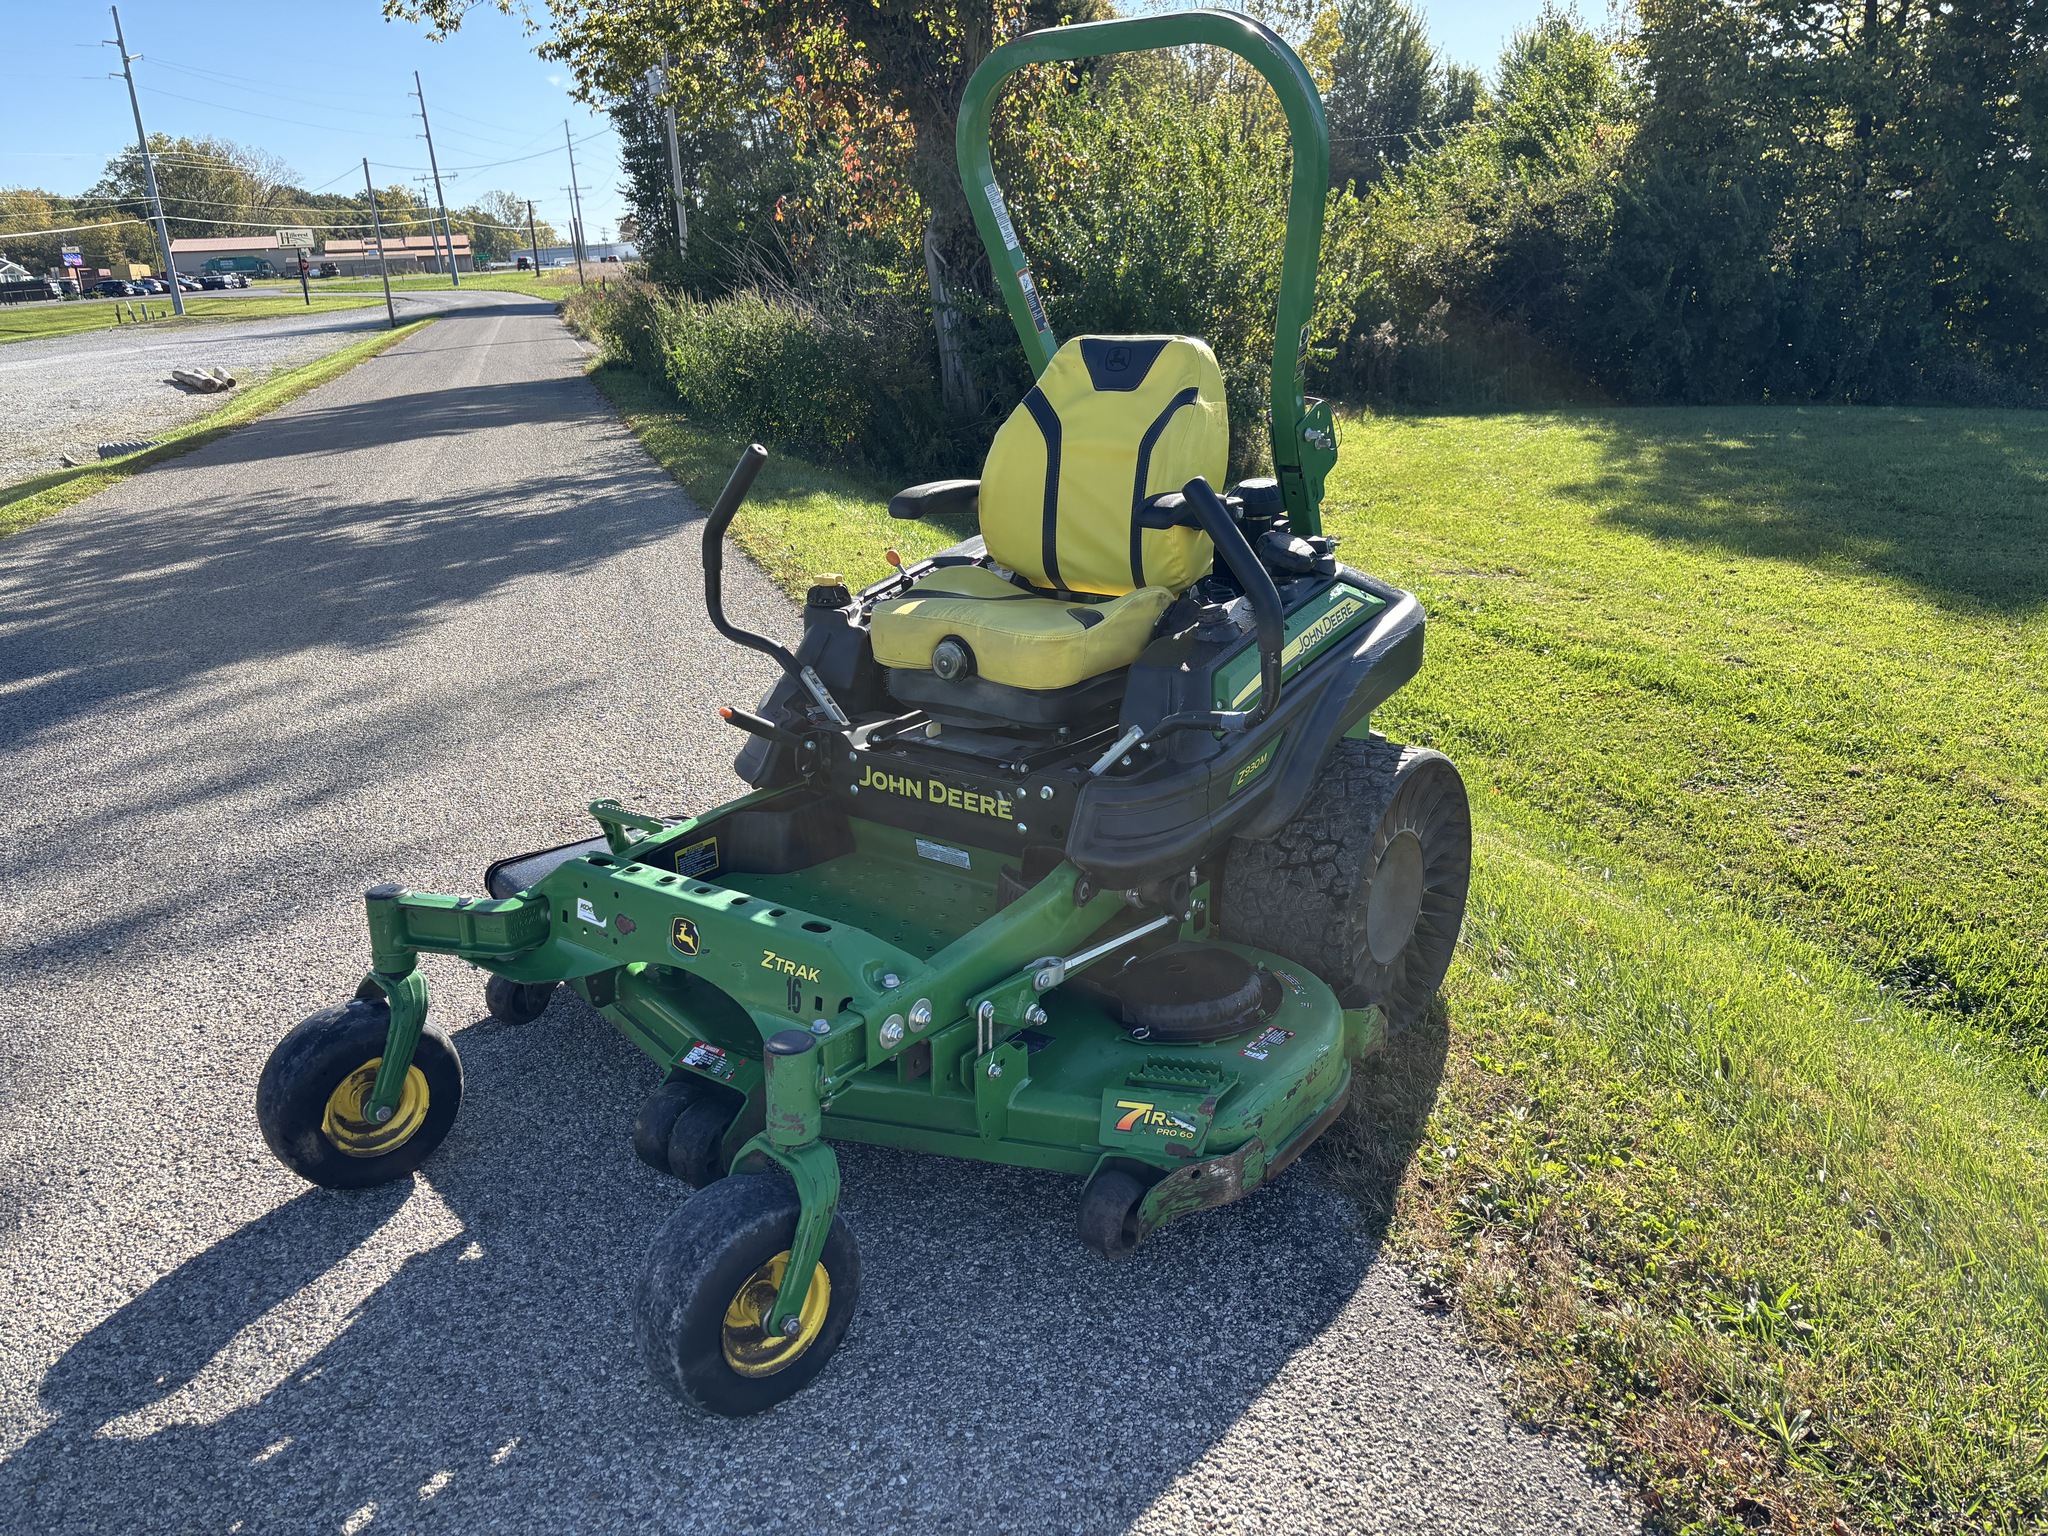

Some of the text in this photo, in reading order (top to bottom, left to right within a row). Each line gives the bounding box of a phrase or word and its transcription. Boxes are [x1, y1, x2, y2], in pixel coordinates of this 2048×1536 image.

[1298, 602, 1354, 654] JOHN DEERE
[1237, 752, 1268, 785] Z930M
[859, 765, 1014, 821] JOHN DEERE
[760, 949, 821, 983] ZTRAK
[787, 976, 802, 1013] 16
[1156, 1128, 1194, 1139] PRO 60
